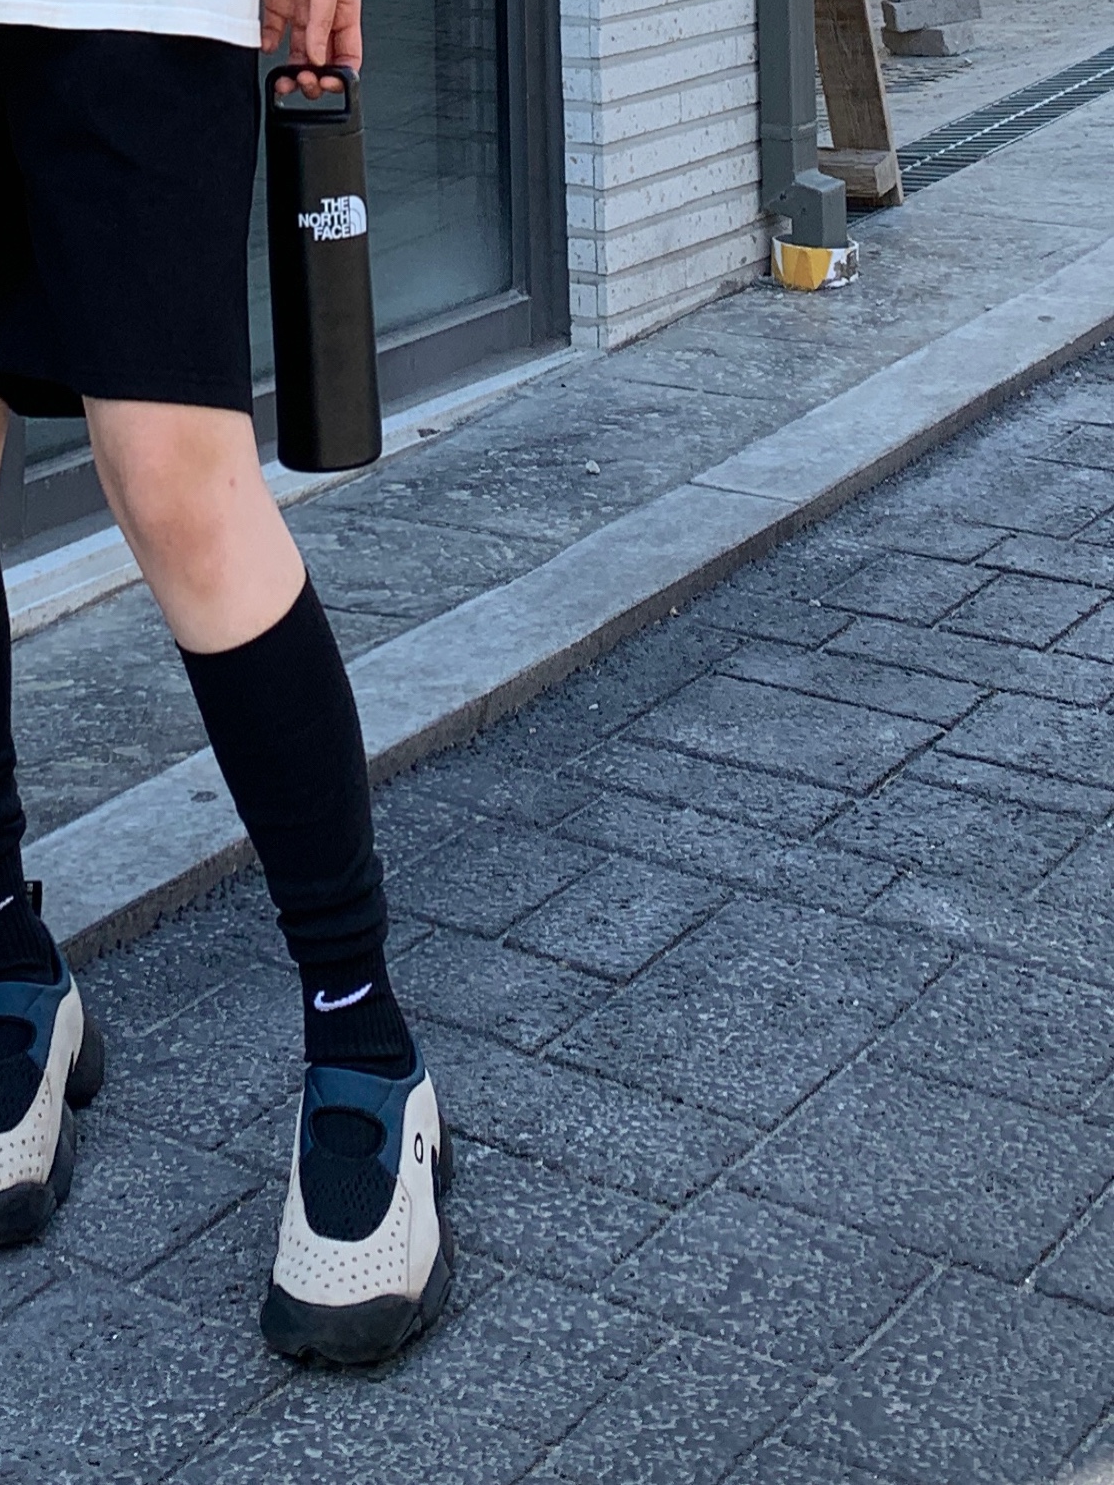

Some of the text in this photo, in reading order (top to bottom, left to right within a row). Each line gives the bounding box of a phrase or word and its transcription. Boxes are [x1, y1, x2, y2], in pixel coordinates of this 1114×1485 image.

[320, 196, 350, 214] THE
[298, 211, 350, 229] NORTH
[313, 225, 351, 242] FACE
